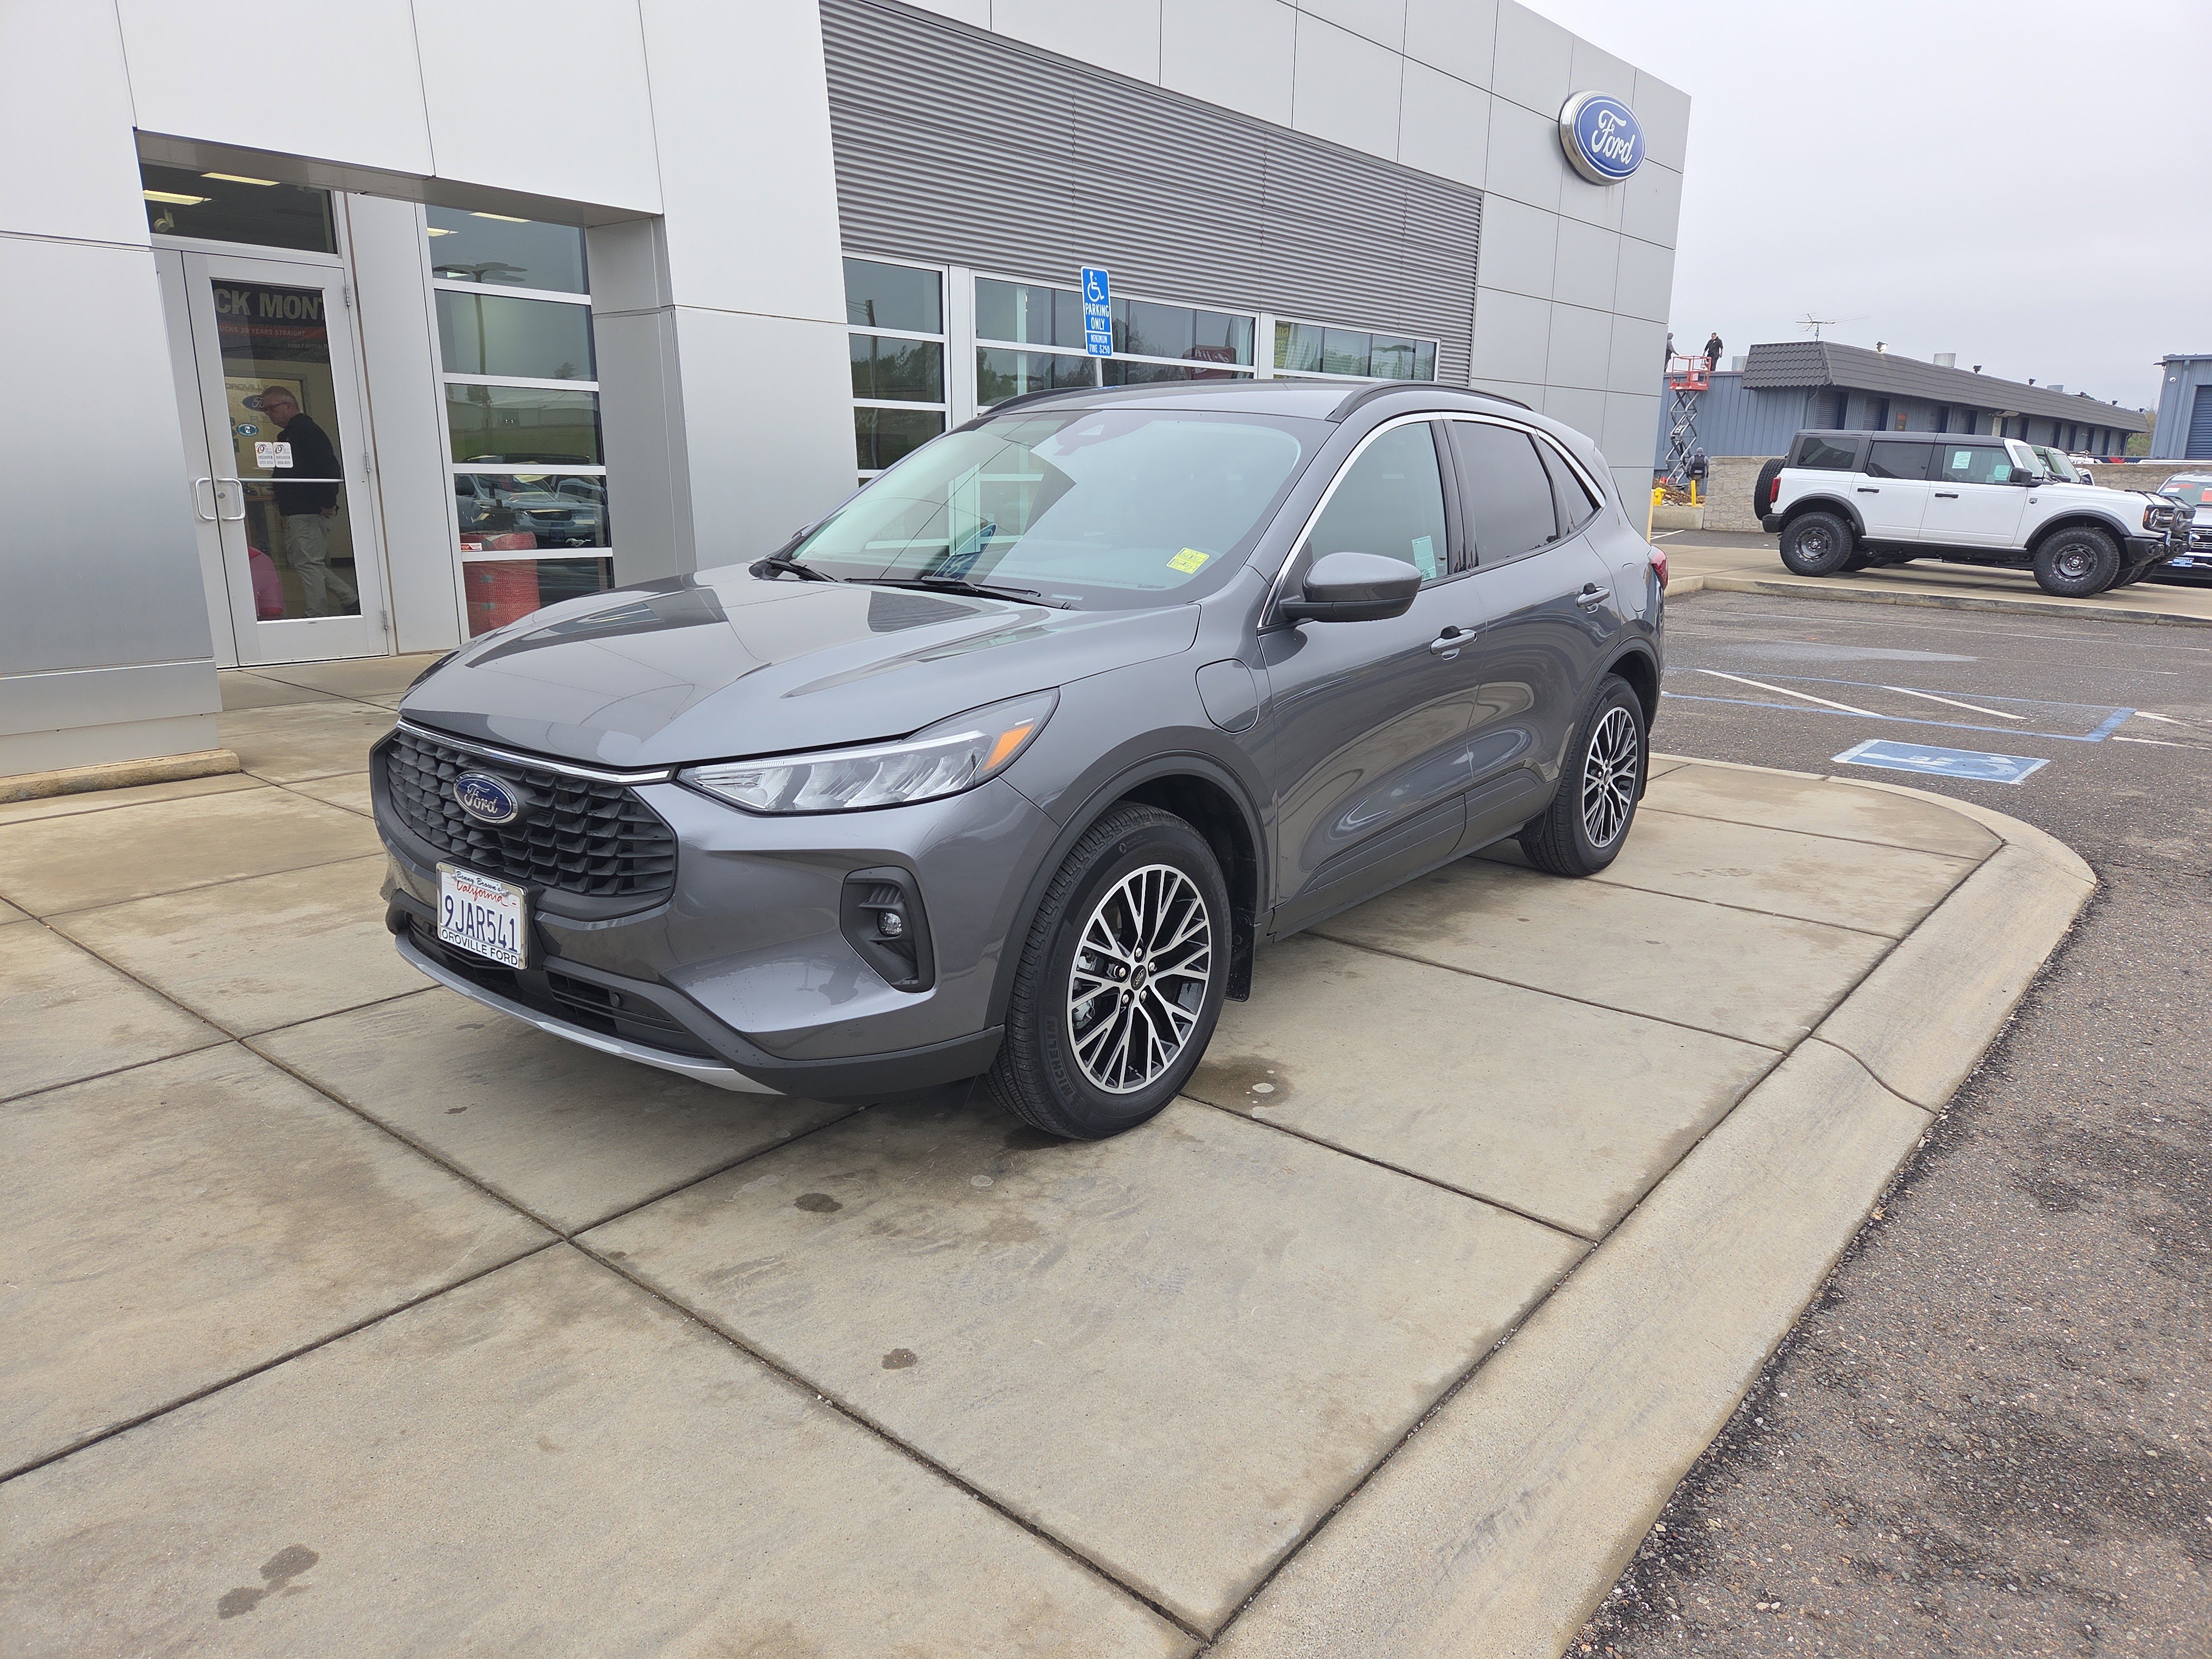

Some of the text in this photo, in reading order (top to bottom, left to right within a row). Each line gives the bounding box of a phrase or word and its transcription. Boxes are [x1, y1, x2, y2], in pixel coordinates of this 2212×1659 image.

[1591, 109, 1636, 165] Ford
[1085, 302, 1109, 318] PARKING
[1090, 317, 1105, 330] ONLY
[1089, 344, 1110, 354] FINE $250
[464, 783, 498, 814] Ford
[456, 871, 501, 891] Benny Brown's
[456, 880, 509, 906] California
[444, 895, 518, 953] 9JAR541
[441, 929, 518, 966] OROVILLE FORD
[1046, 1019, 1073, 1098] MICHELIN
